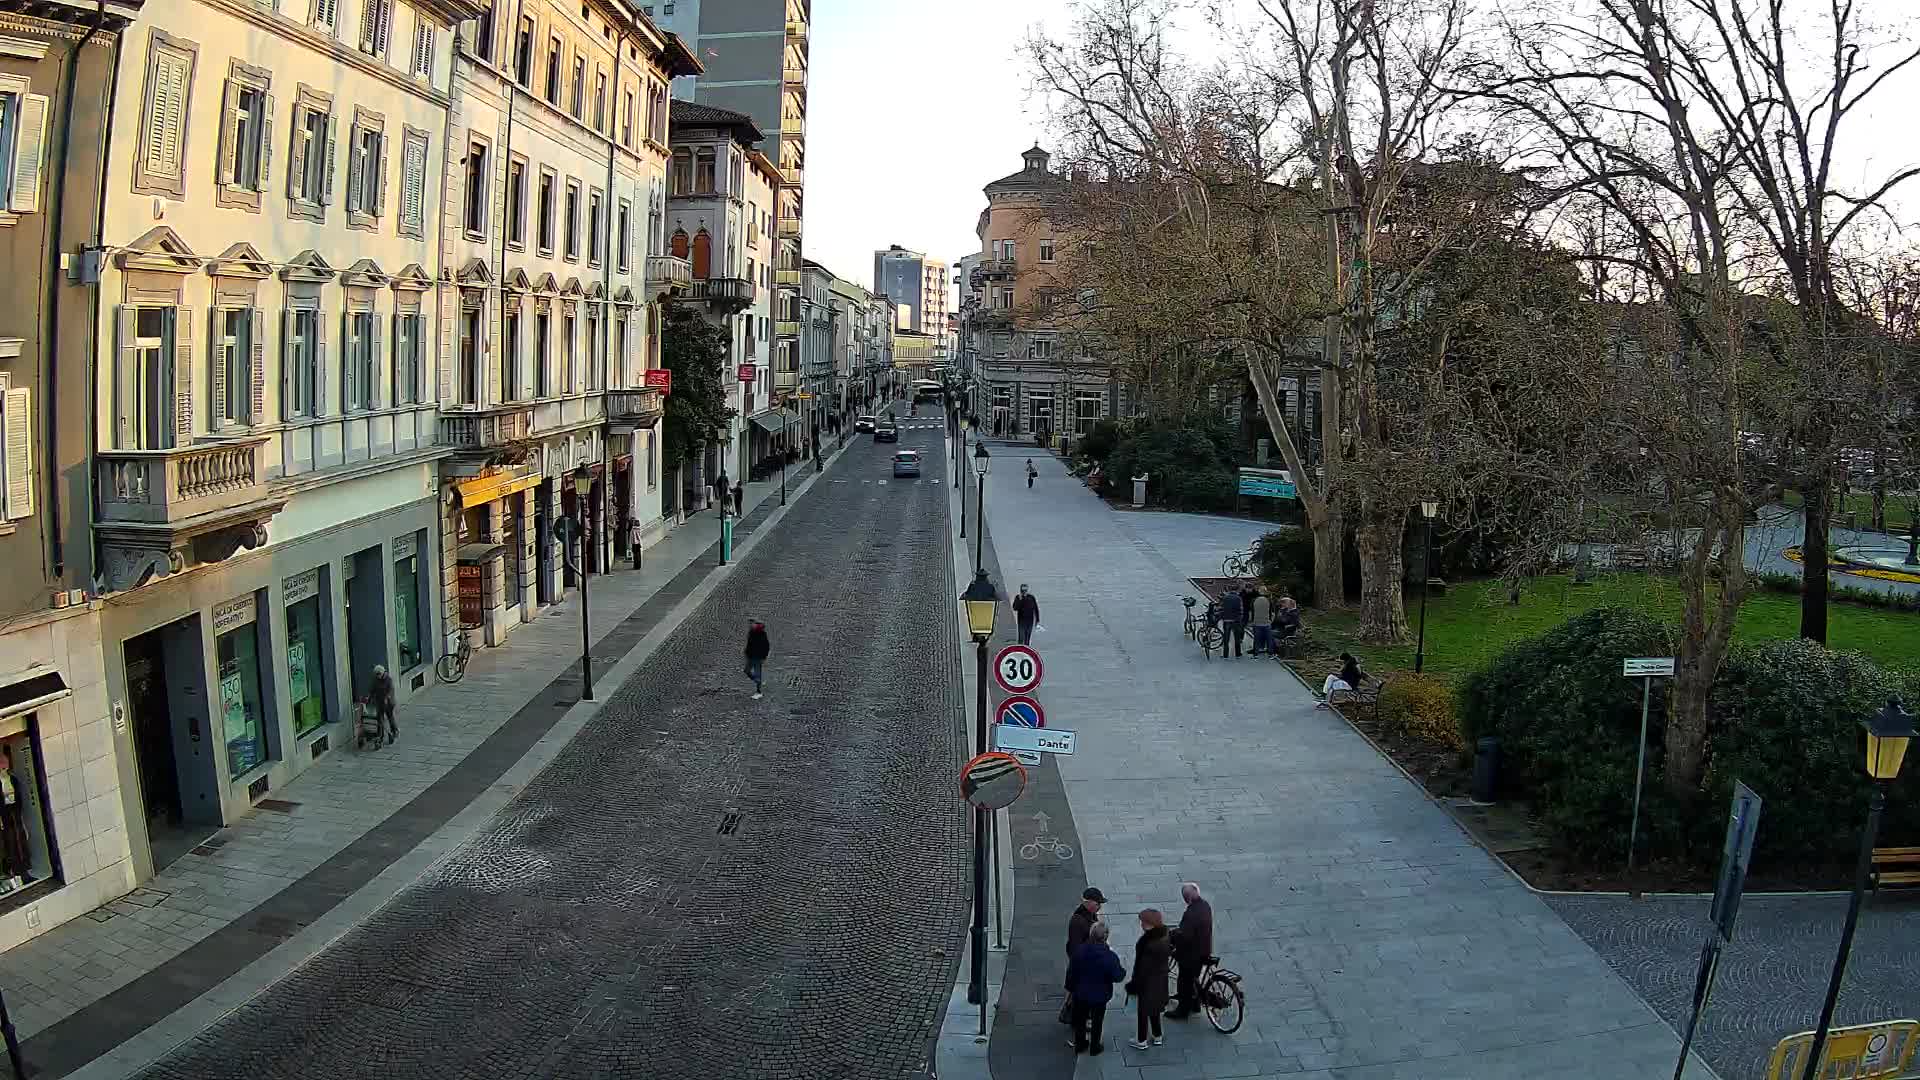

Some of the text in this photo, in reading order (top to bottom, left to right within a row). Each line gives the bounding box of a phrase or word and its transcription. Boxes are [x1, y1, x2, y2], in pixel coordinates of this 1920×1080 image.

[215, 612, 244, 629] OPERATIVO
[1005, 658, 1033, 681] 30
[222, 677, 240, 700] 130
[1038, 738, 1069, 750] Dante
